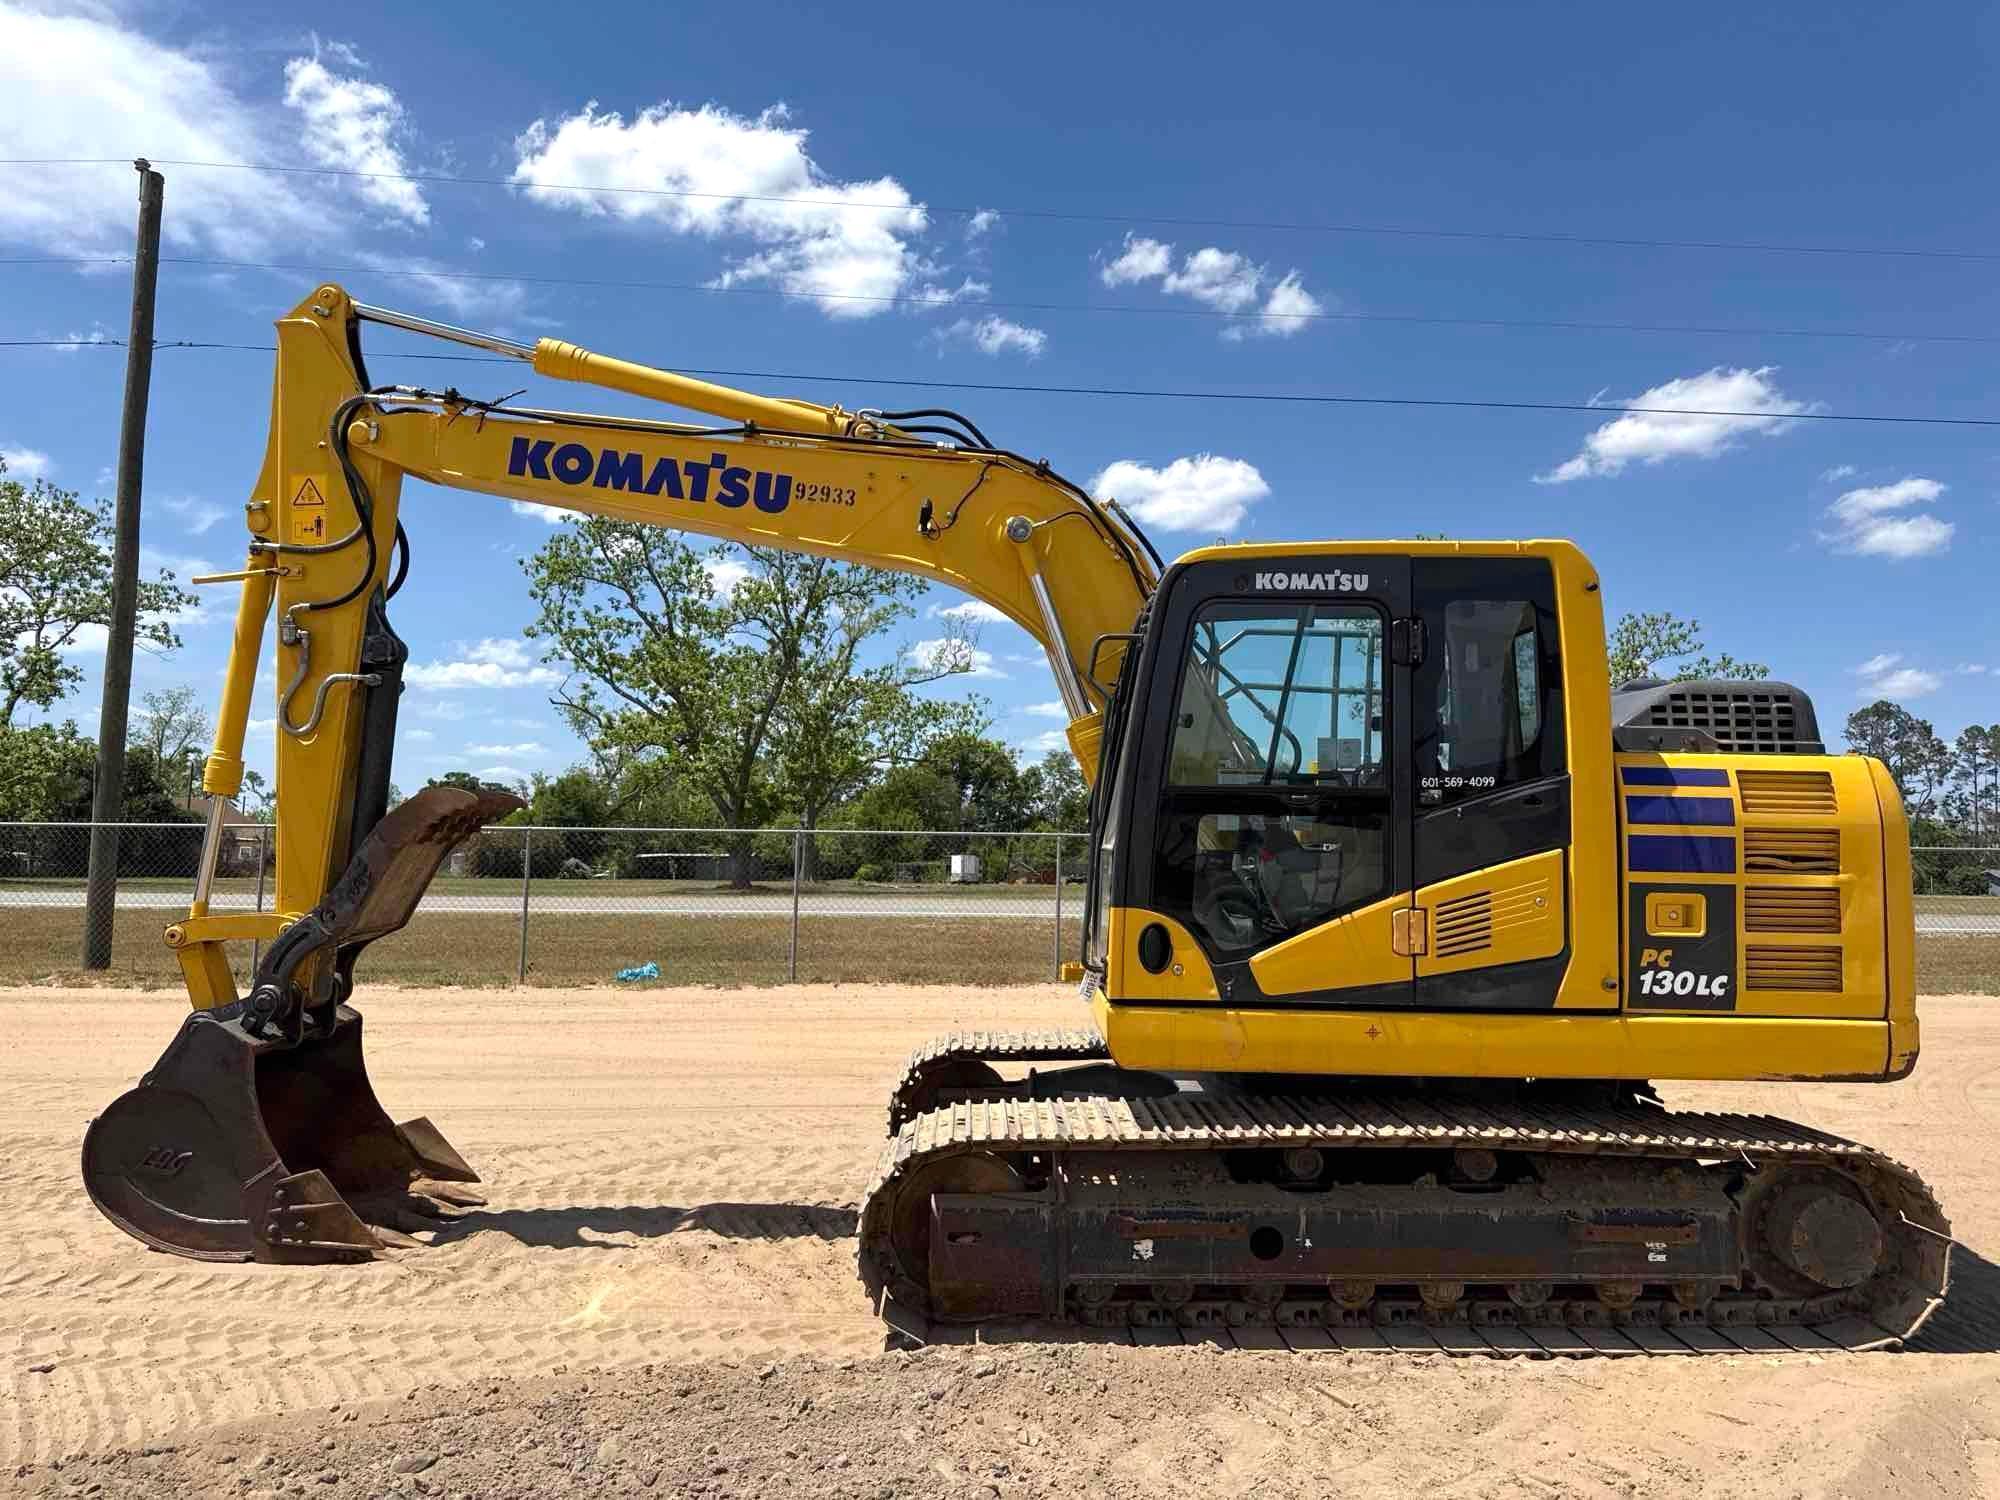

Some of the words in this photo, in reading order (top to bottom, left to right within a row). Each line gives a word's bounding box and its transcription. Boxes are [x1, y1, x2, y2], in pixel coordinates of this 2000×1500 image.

[508, 437, 793, 514] KOMATSU
[795, 481, 857, 507] 92933
[1255, 569, 1369, 592] KOMATSU
[1421, 776, 1496, 788] 601-569-4099
[1640, 948, 1673, 968] PC
[1639, 970, 1729, 998] 130LC
